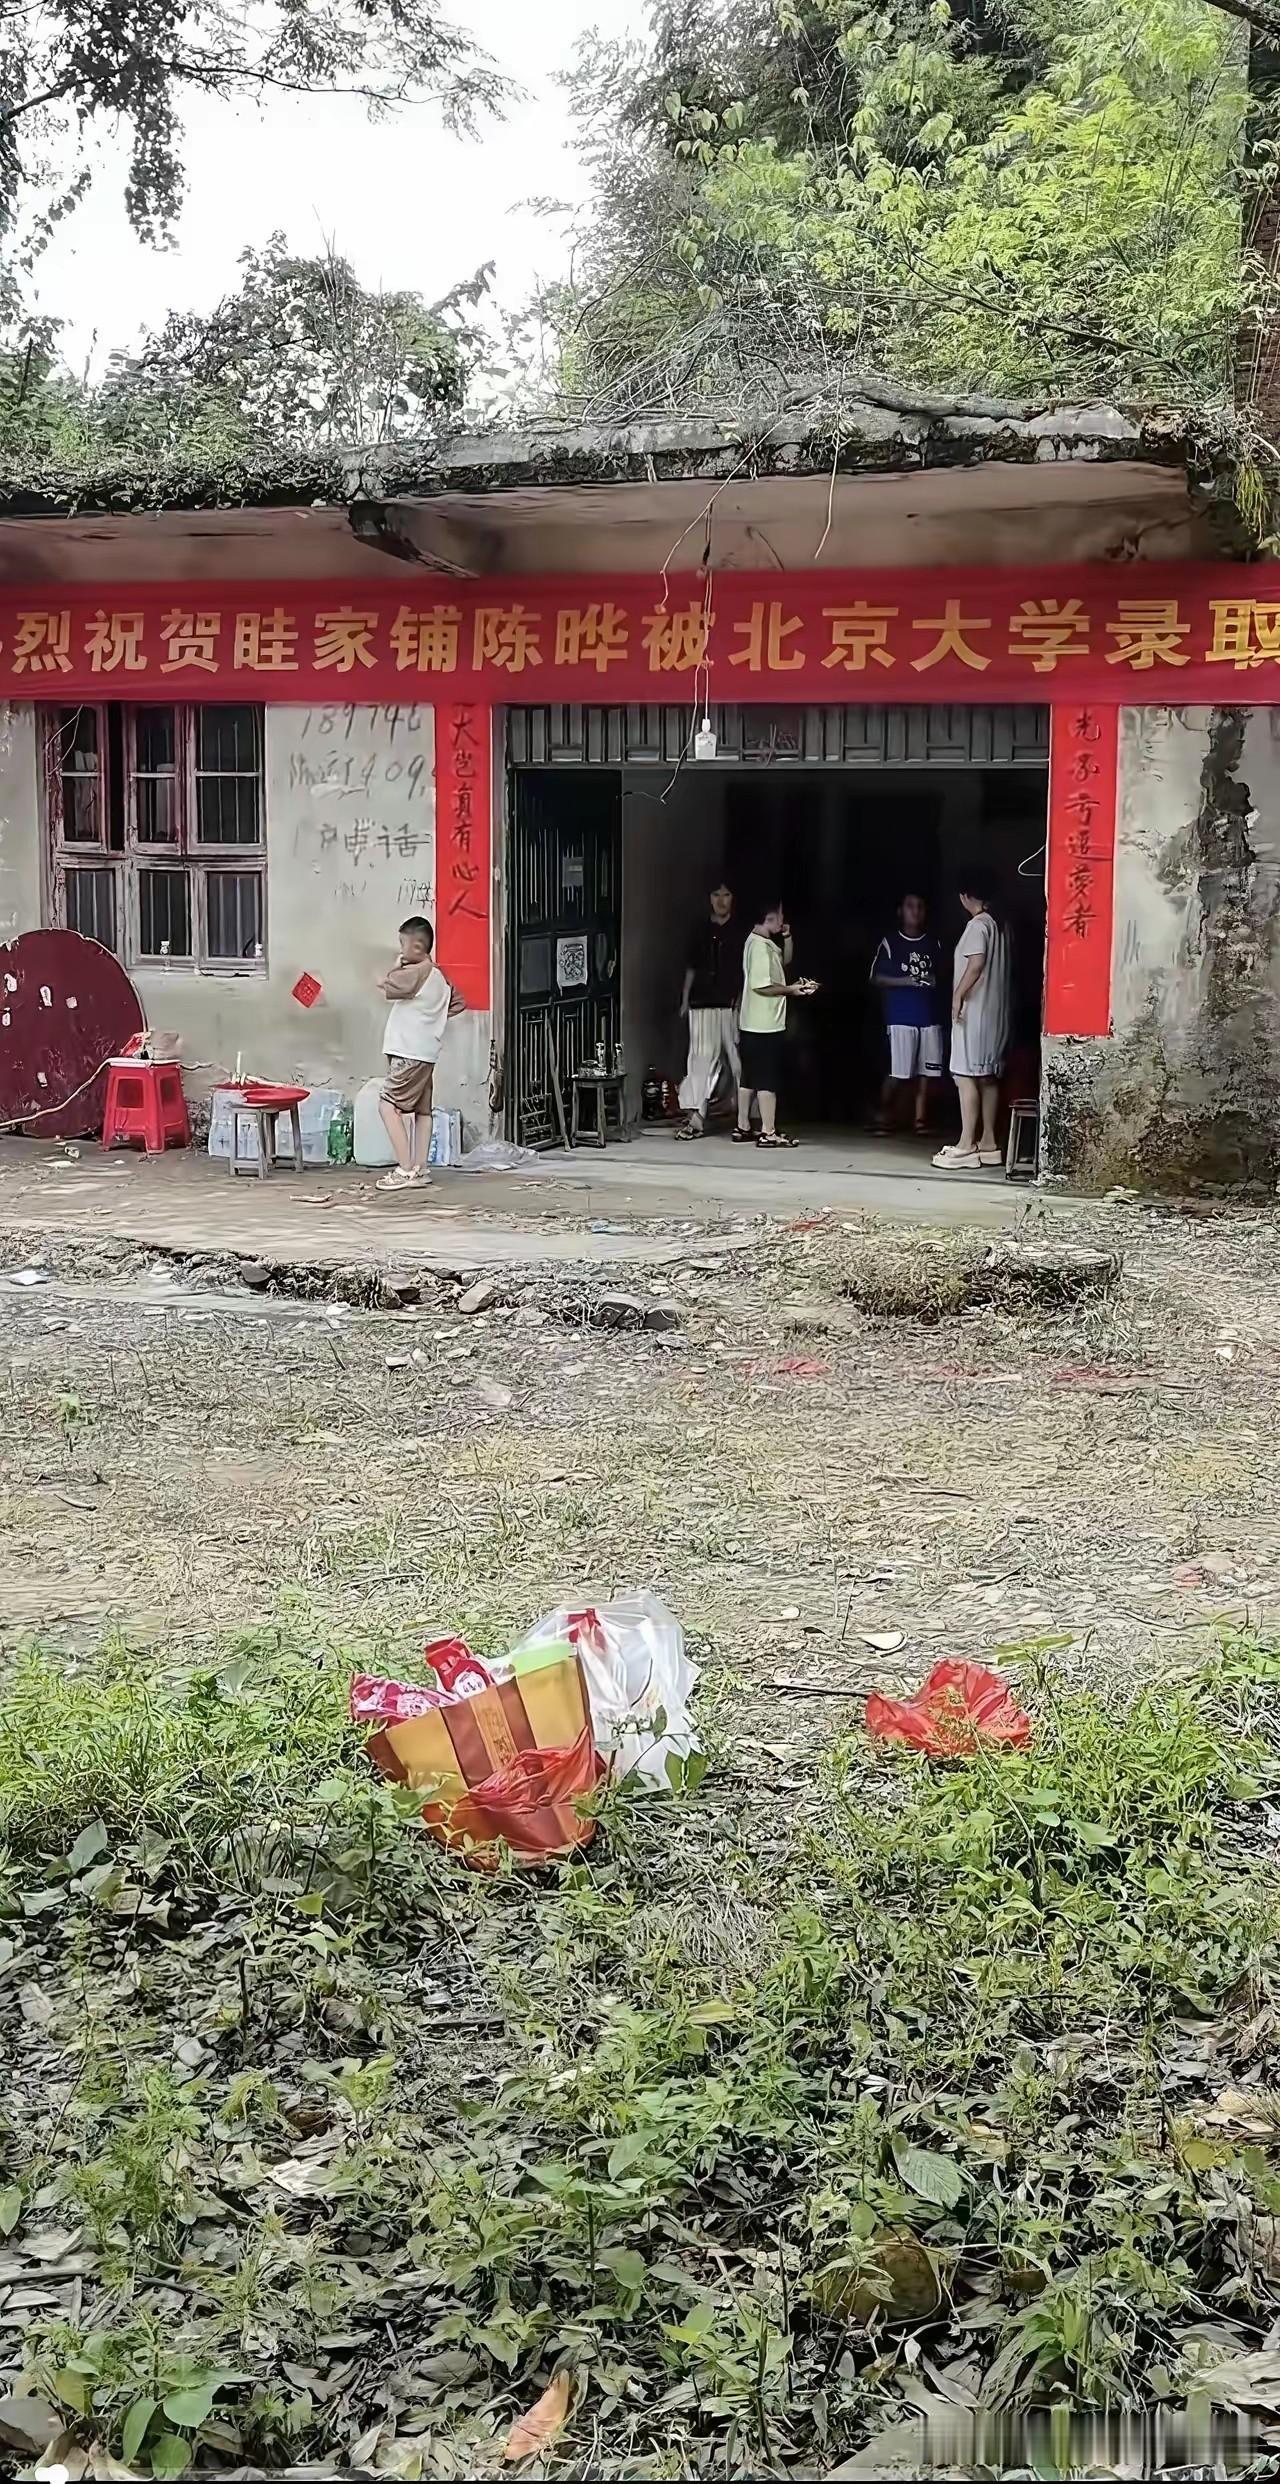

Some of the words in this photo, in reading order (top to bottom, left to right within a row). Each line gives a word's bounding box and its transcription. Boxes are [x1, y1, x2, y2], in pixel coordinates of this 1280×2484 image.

[0, 598, 1280, 674] 烈祝贺眭家铺陈晔被北京大学录取
